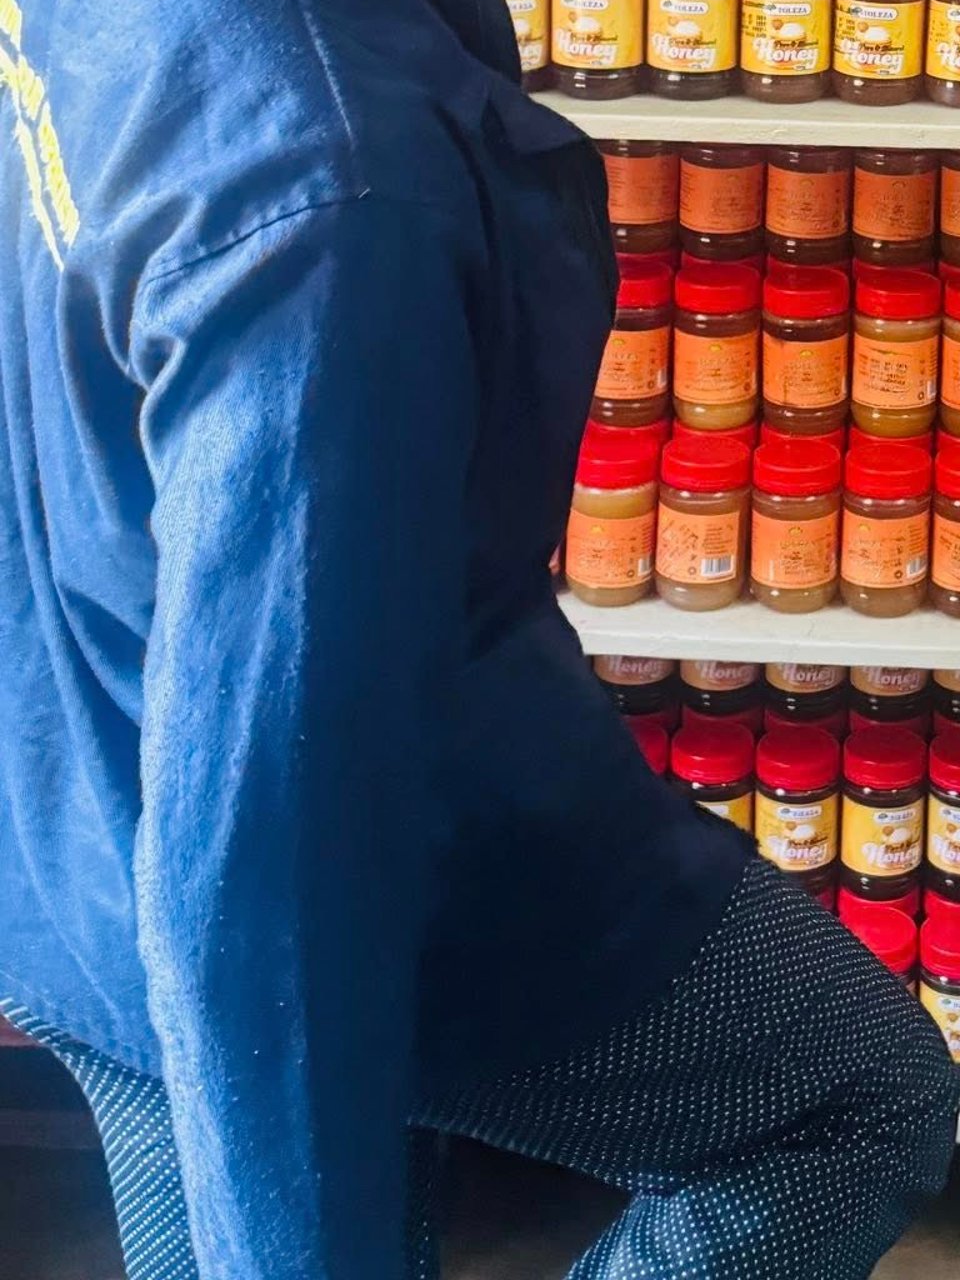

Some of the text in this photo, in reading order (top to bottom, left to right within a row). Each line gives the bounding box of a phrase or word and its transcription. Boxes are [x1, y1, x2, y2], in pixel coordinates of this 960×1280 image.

[551, 29, 616, 67] Honey
[654, 32, 715, 70] Honey
[753, 40, 818, 72] Honey
[841, 42, 903, 75] Honey
